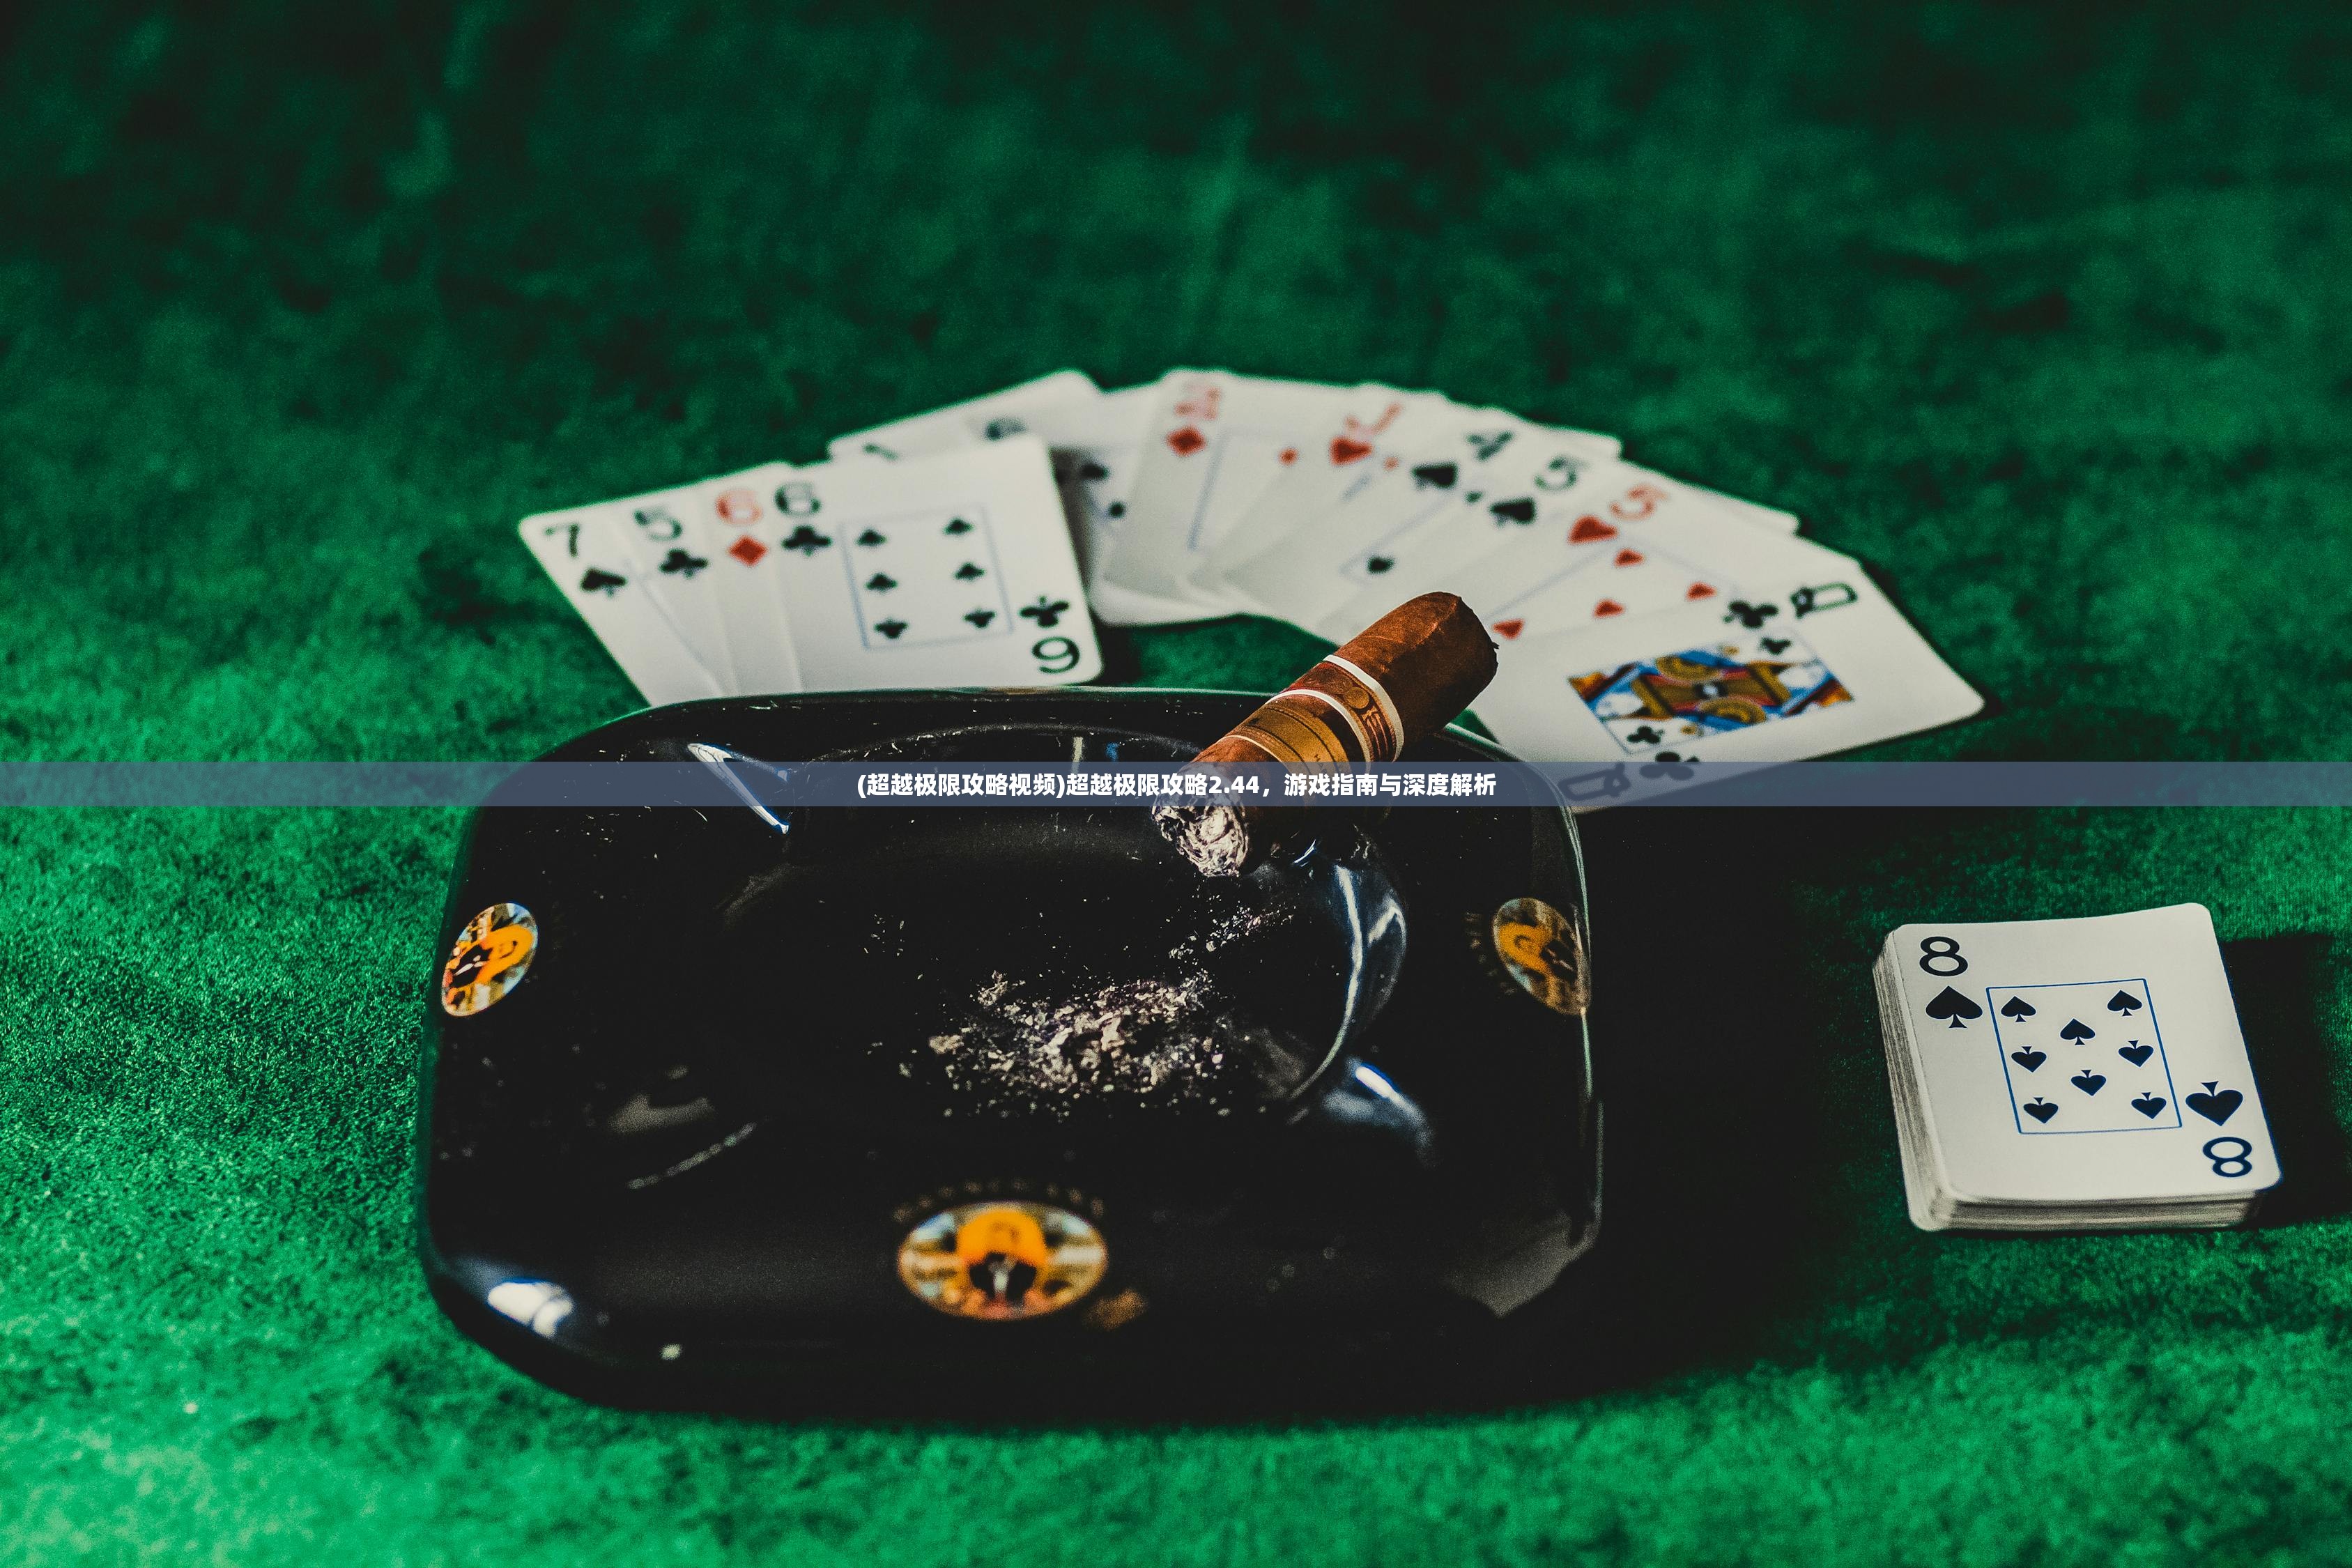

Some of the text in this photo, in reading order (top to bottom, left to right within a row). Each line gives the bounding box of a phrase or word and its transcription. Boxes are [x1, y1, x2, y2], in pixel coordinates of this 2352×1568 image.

[1534, 455, 1590, 492] 5
[1609, 484, 1668, 521] 5
[544, 523, 581, 558] 7
[633, 507, 683, 541] 5
[1790, 581, 1858, 619] Q
[1919, 936, 1969, 977] 8
[2202, 1136, 2252, 1178] 8
